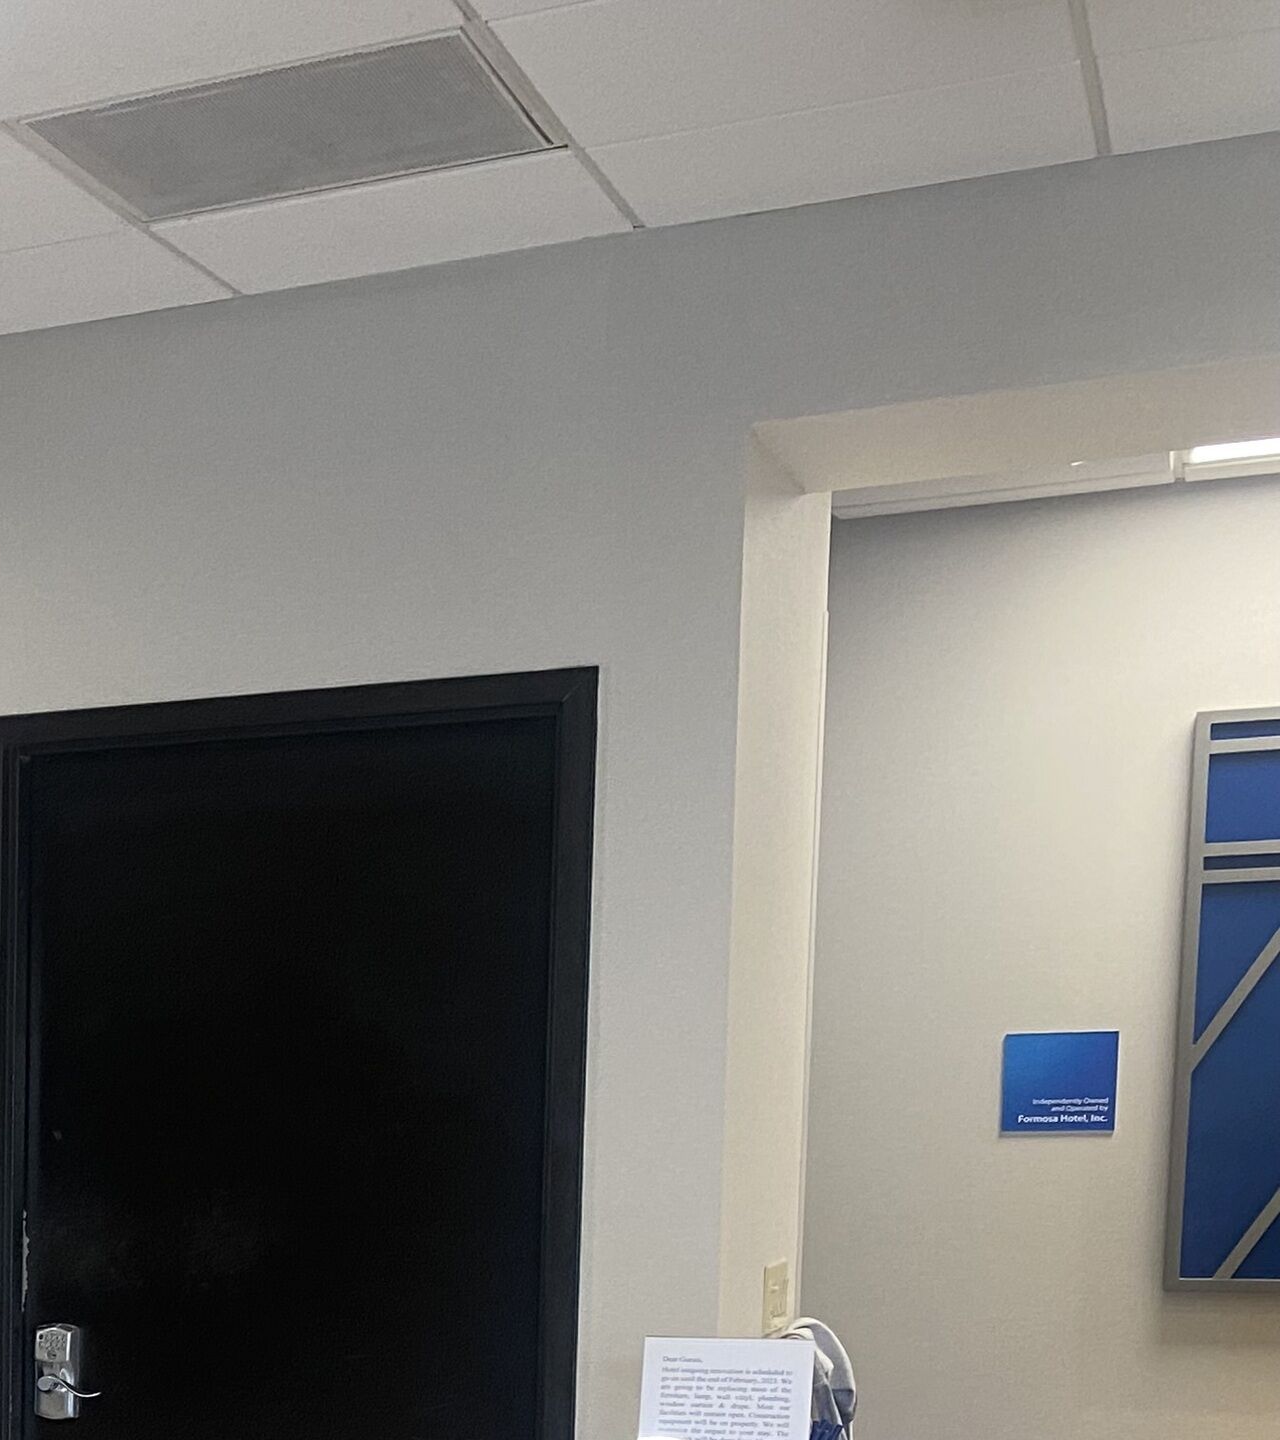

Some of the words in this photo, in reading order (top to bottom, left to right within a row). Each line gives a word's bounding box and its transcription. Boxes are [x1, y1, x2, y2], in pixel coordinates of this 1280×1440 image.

[1018, 1114, 1059, 1123] Formosa
[1060, 1114, 1089, 1123] Hotel,
[1090, 1114, 1109, 1122] Inc.
